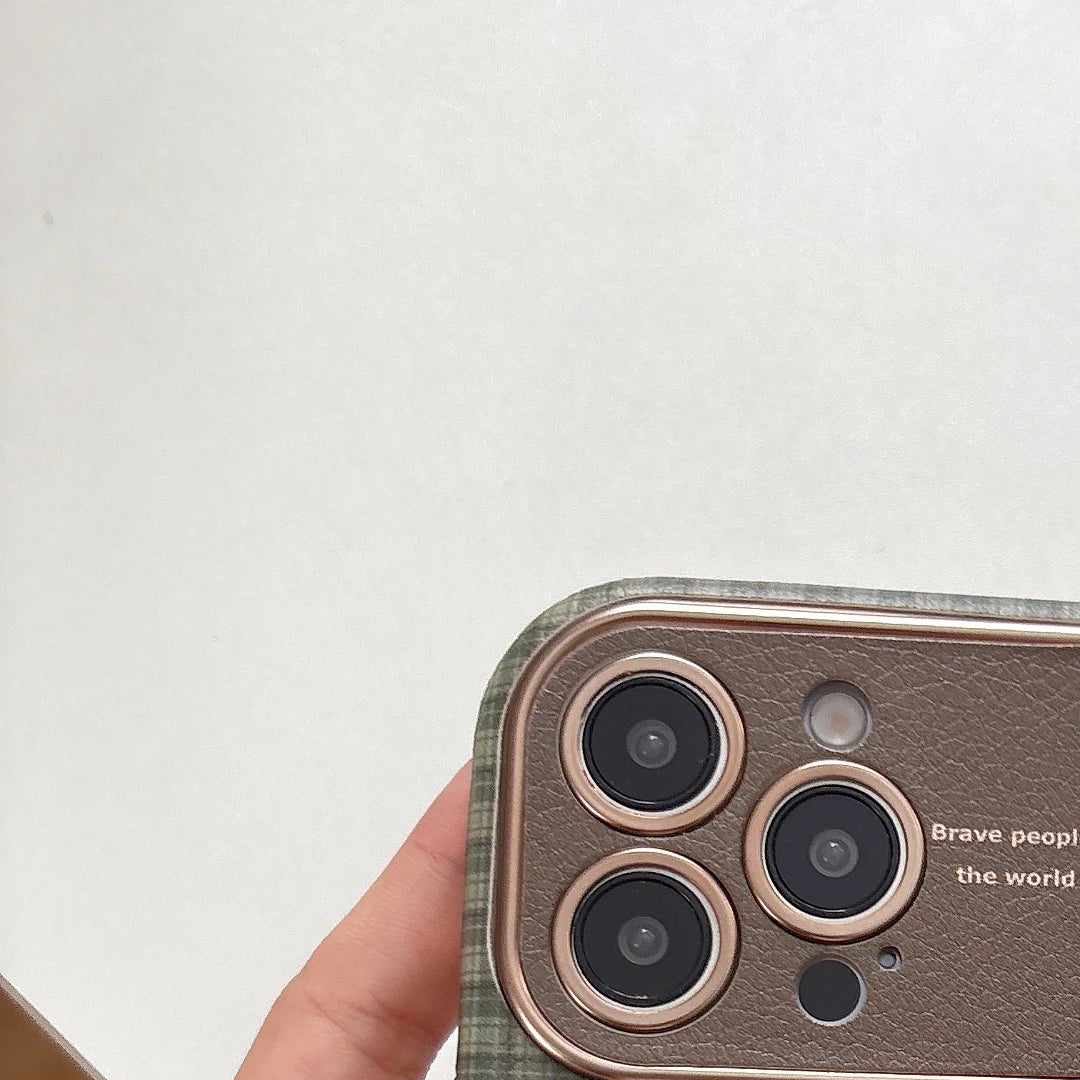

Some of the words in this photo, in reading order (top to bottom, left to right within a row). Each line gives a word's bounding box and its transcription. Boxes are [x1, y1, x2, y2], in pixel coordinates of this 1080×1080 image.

[931, 823, 1002, 843] Brave
[956, 866, 997, 885] the
[1005, 869, 1075, 888] world
